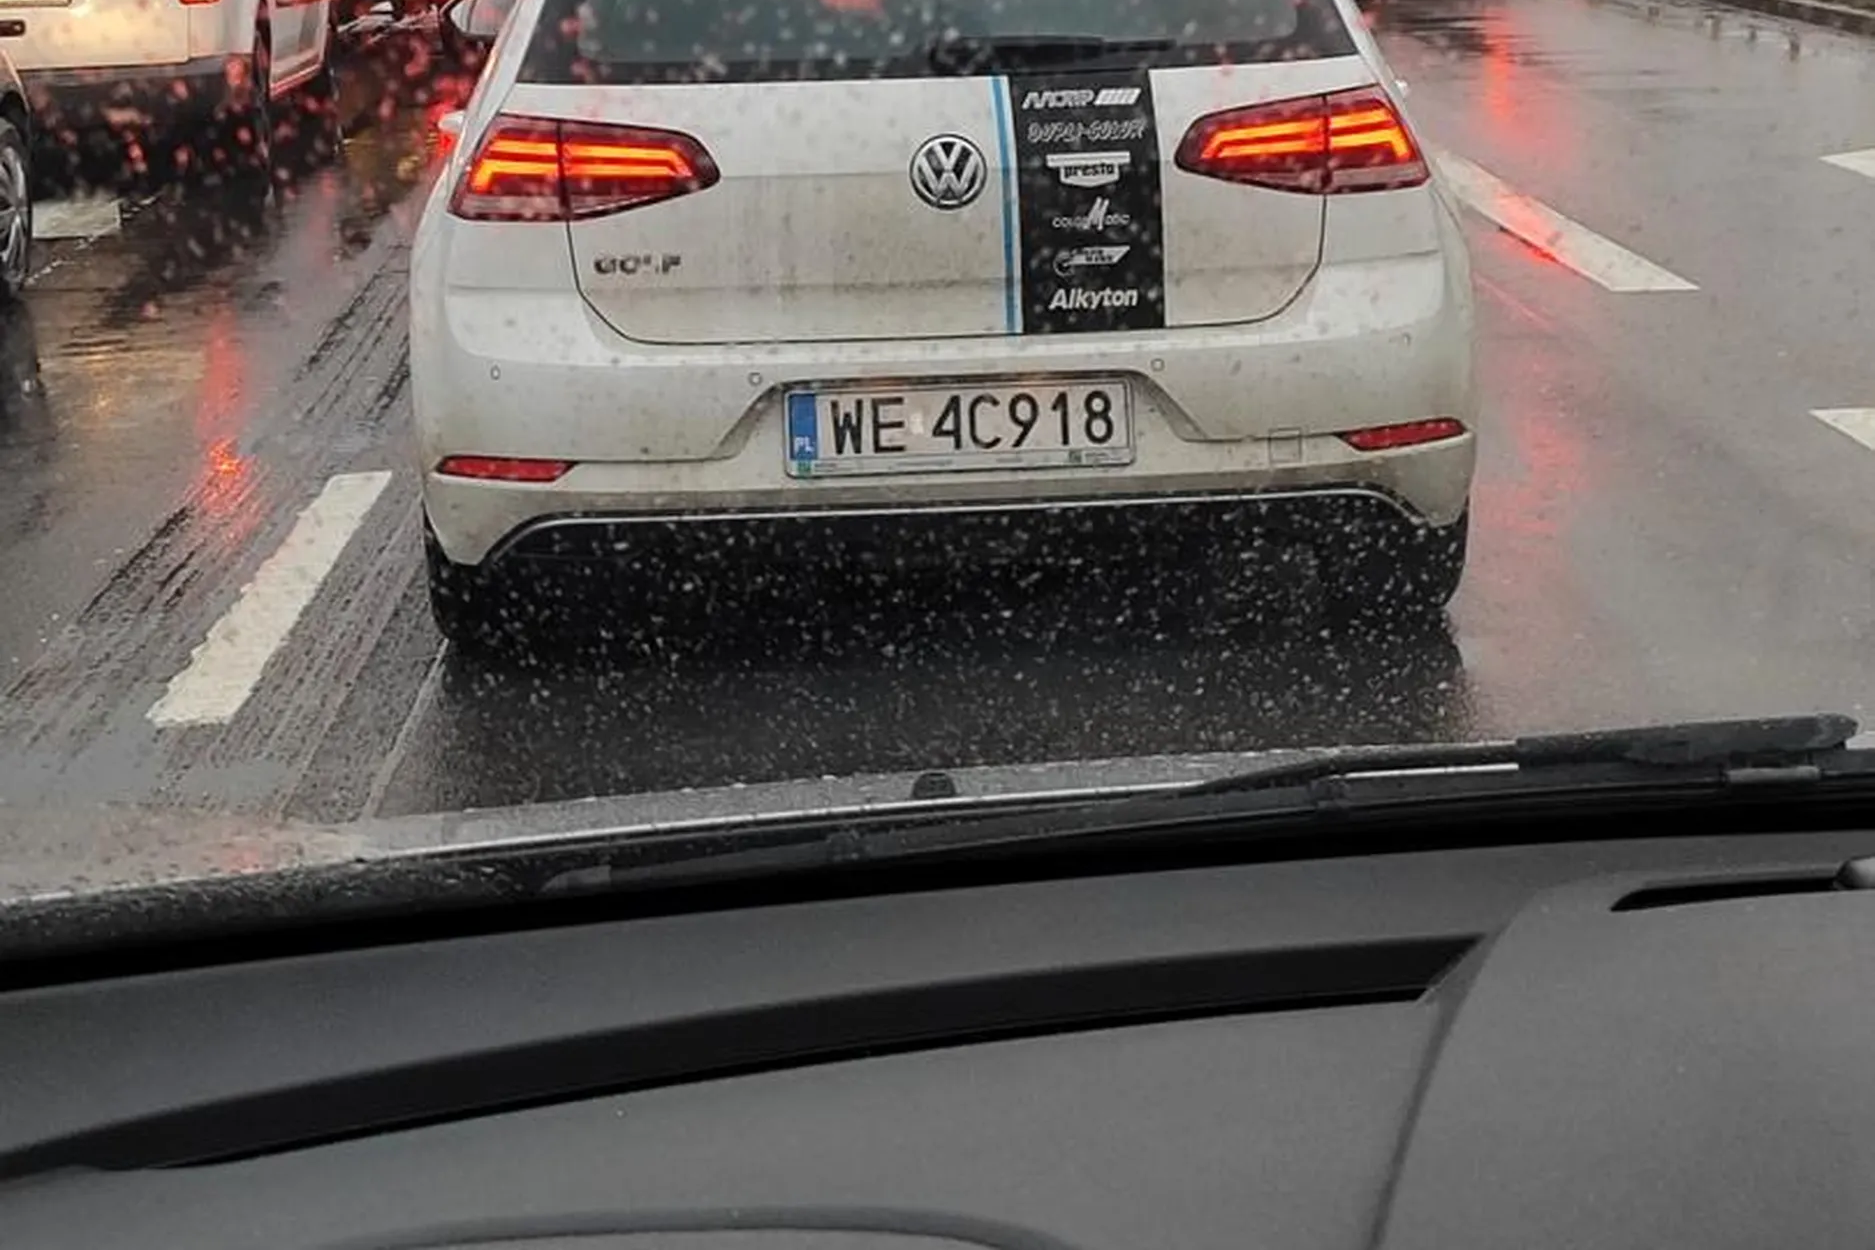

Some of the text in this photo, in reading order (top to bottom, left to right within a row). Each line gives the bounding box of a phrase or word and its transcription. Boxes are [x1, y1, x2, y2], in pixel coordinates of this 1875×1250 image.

[1048, 287, 1139, 310] Alkyton
[830, 391, 1114, 454] WE 4C918
